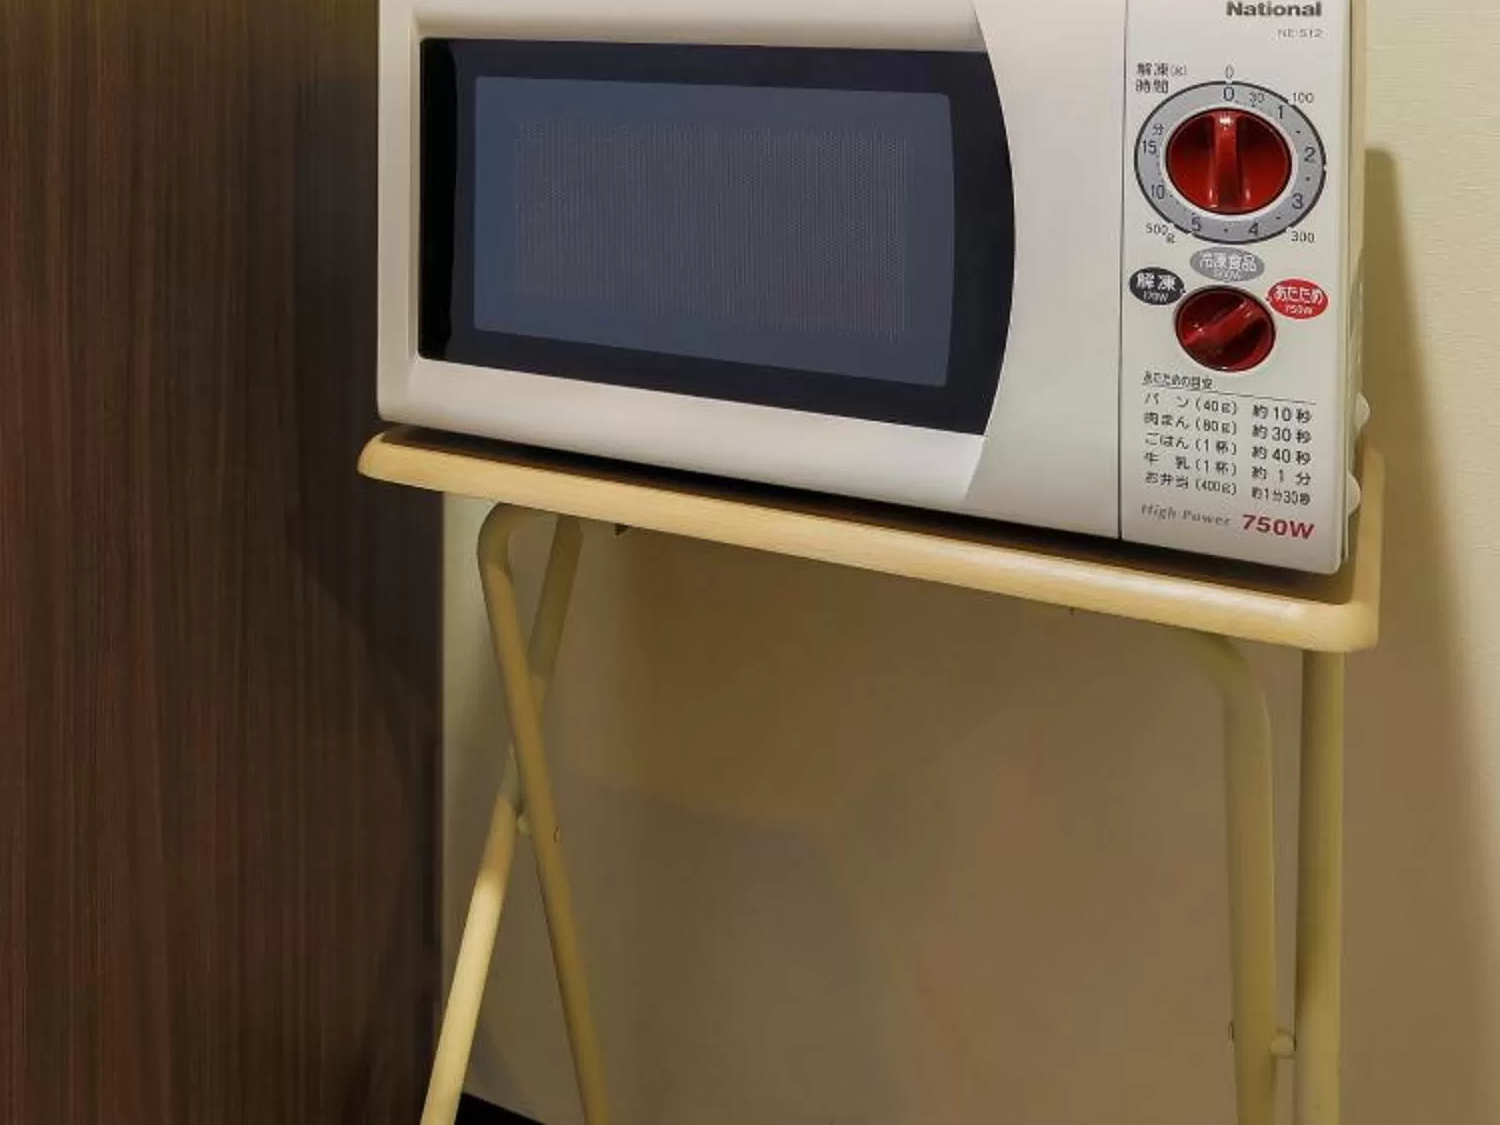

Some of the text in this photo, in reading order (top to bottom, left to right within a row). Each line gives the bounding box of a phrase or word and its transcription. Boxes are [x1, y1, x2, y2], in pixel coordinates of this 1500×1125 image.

[1226, 0, 1322, 17] National
[1293, 92, 1315, 104] 100
[1142, 139, 1157, 155] 15
[1304, 146, 1316, 163] 2
[1151, 184, 1165, 200] 10
[1291, 193, 1304, 210] 3
[1248, 222, 1259, 236] 4
[1291, 230, 1315, 244] 300
[1136, 272, 1177, 292] 解凍
[1274, 285, 1324, 305] あたため
[1141, 502, 1316, 540] High Power 750W
